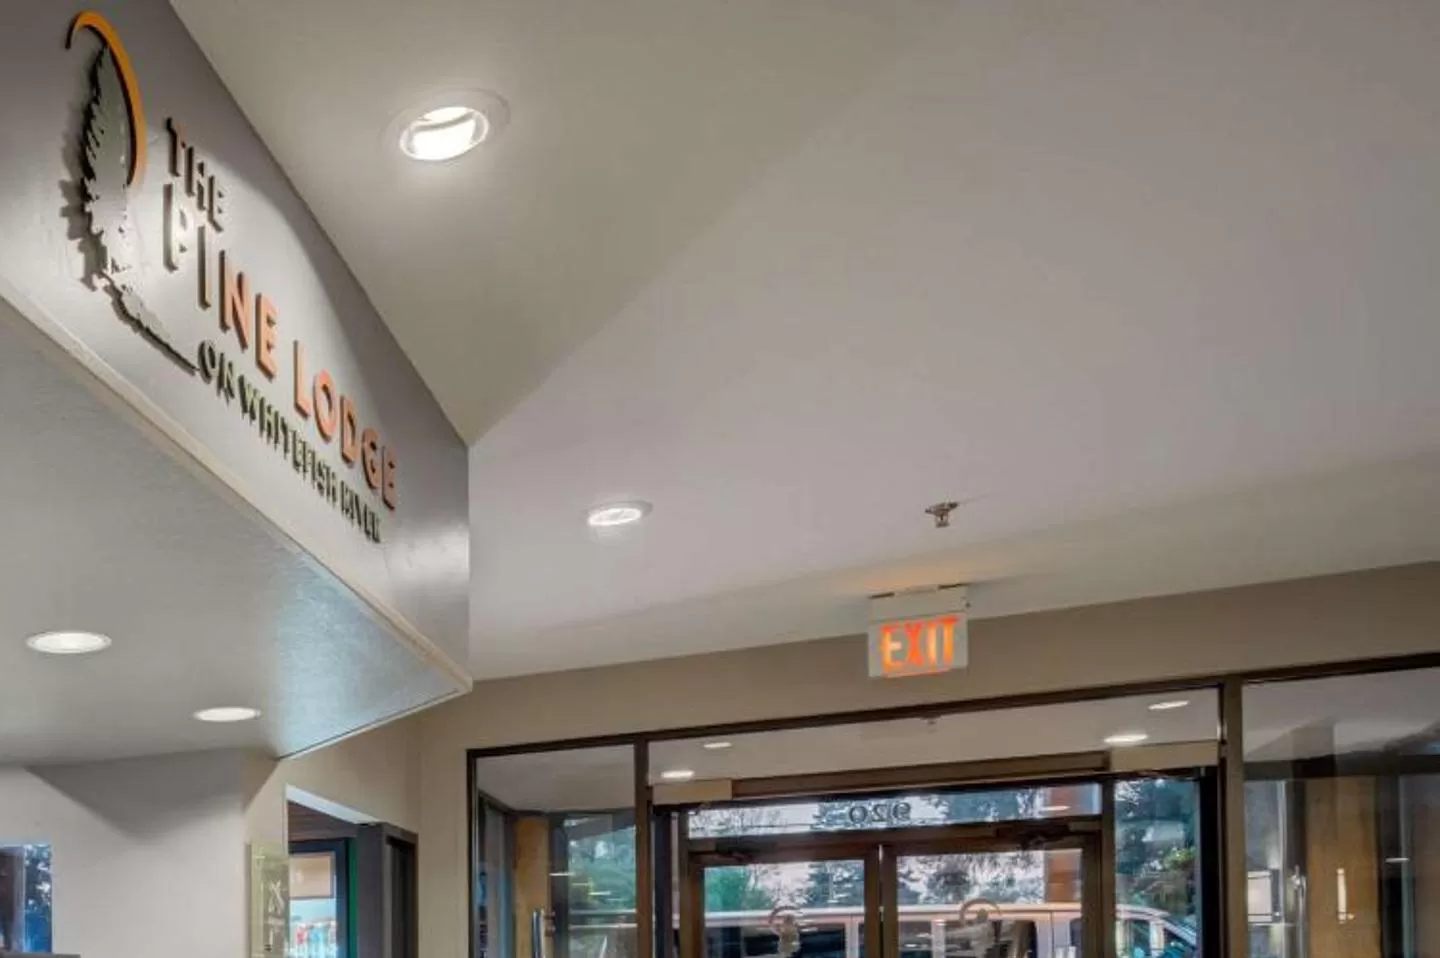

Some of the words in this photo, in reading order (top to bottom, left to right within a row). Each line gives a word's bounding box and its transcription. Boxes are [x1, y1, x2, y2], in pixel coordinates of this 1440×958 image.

[165, 116, 224, 233] THE
[162, 182, 279, 383] PINE
[293, 338, 398, 512] LODGE
[197, 339, 236, 404] ON
[880, 615, 959, 675] EXIT
